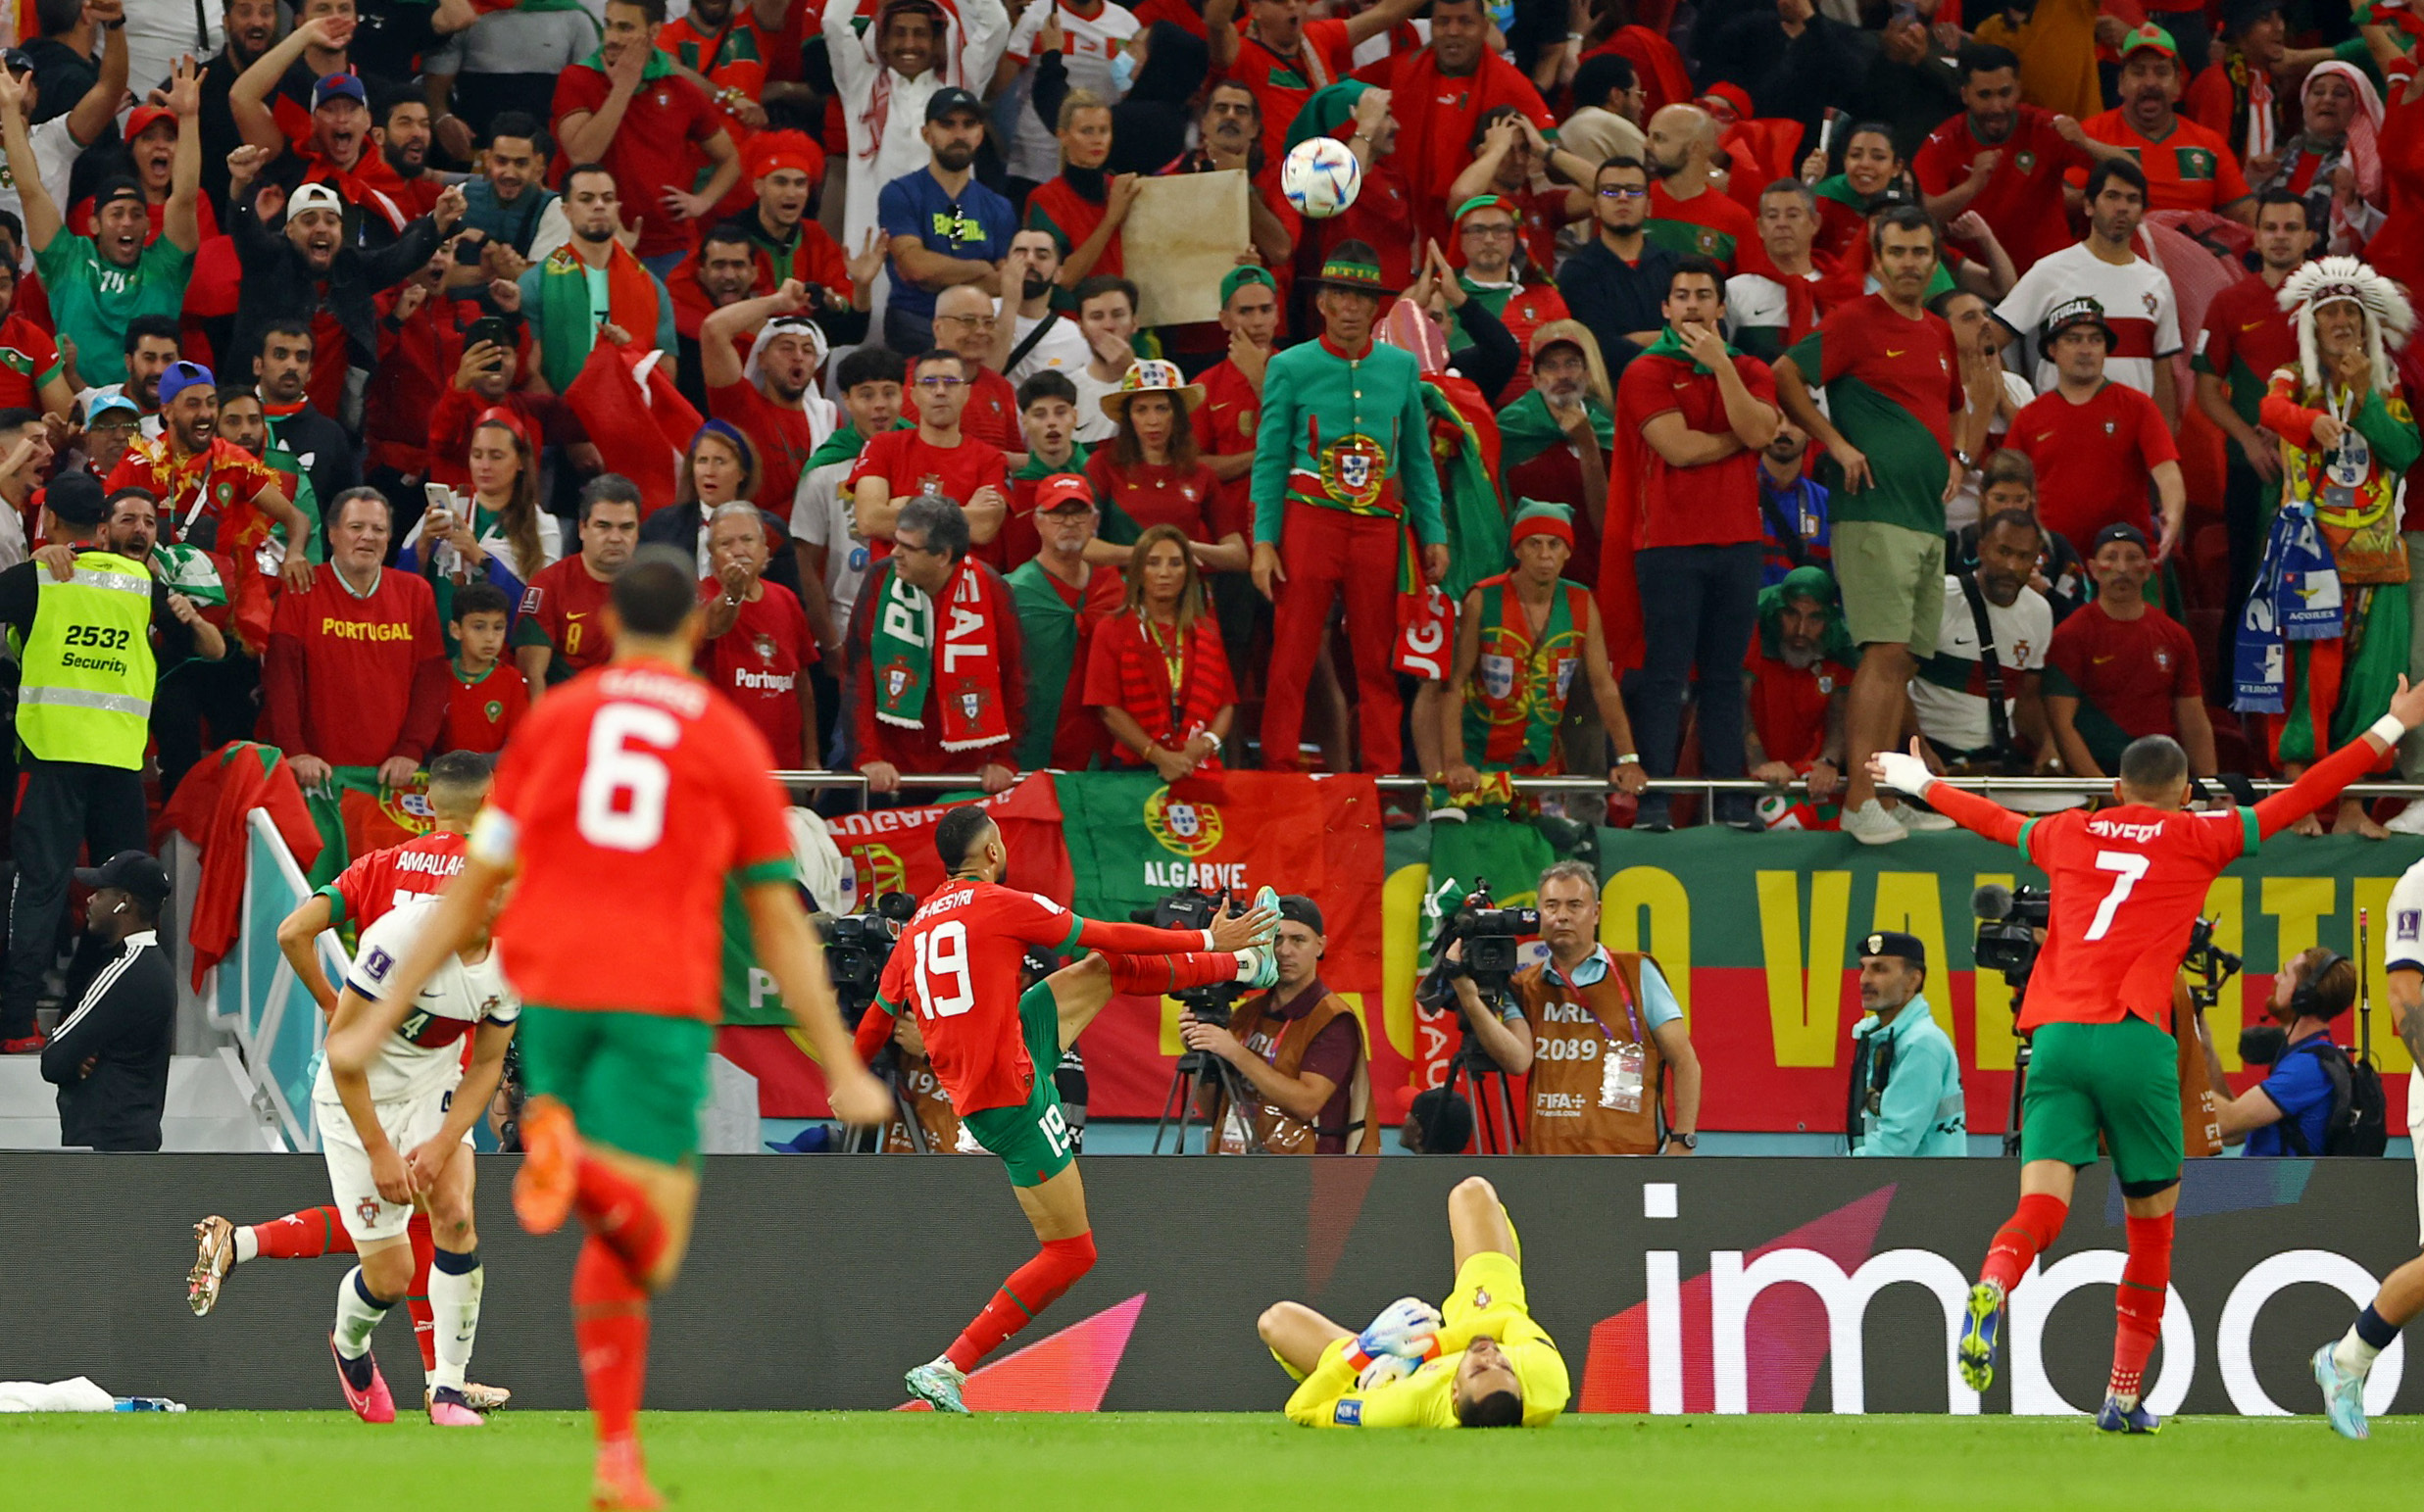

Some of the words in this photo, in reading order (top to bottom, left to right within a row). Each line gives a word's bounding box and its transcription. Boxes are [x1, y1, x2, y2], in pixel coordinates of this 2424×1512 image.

[64, 625, 129, 650] 2532
[322, 617, 414, 642] PORTUGAL
[566, 622, 582, 656] 8
[61, 652, 127, 676] Security
[735, 667, 796, 692] Portugal
[576, 700, 681, 854] 6
[1144, 860, 1248, 889] ALGARVE.
[2083, 850, 2151, 941] 7
[914, 919, 975, 1021] 19
[402, 1012, 429, 1039] 4
[1544, 1001, 1595, 1023] MRL
[1535, 1037, 1598, 1061] 2089
[1038, 1103, 1070, 1158] 19
